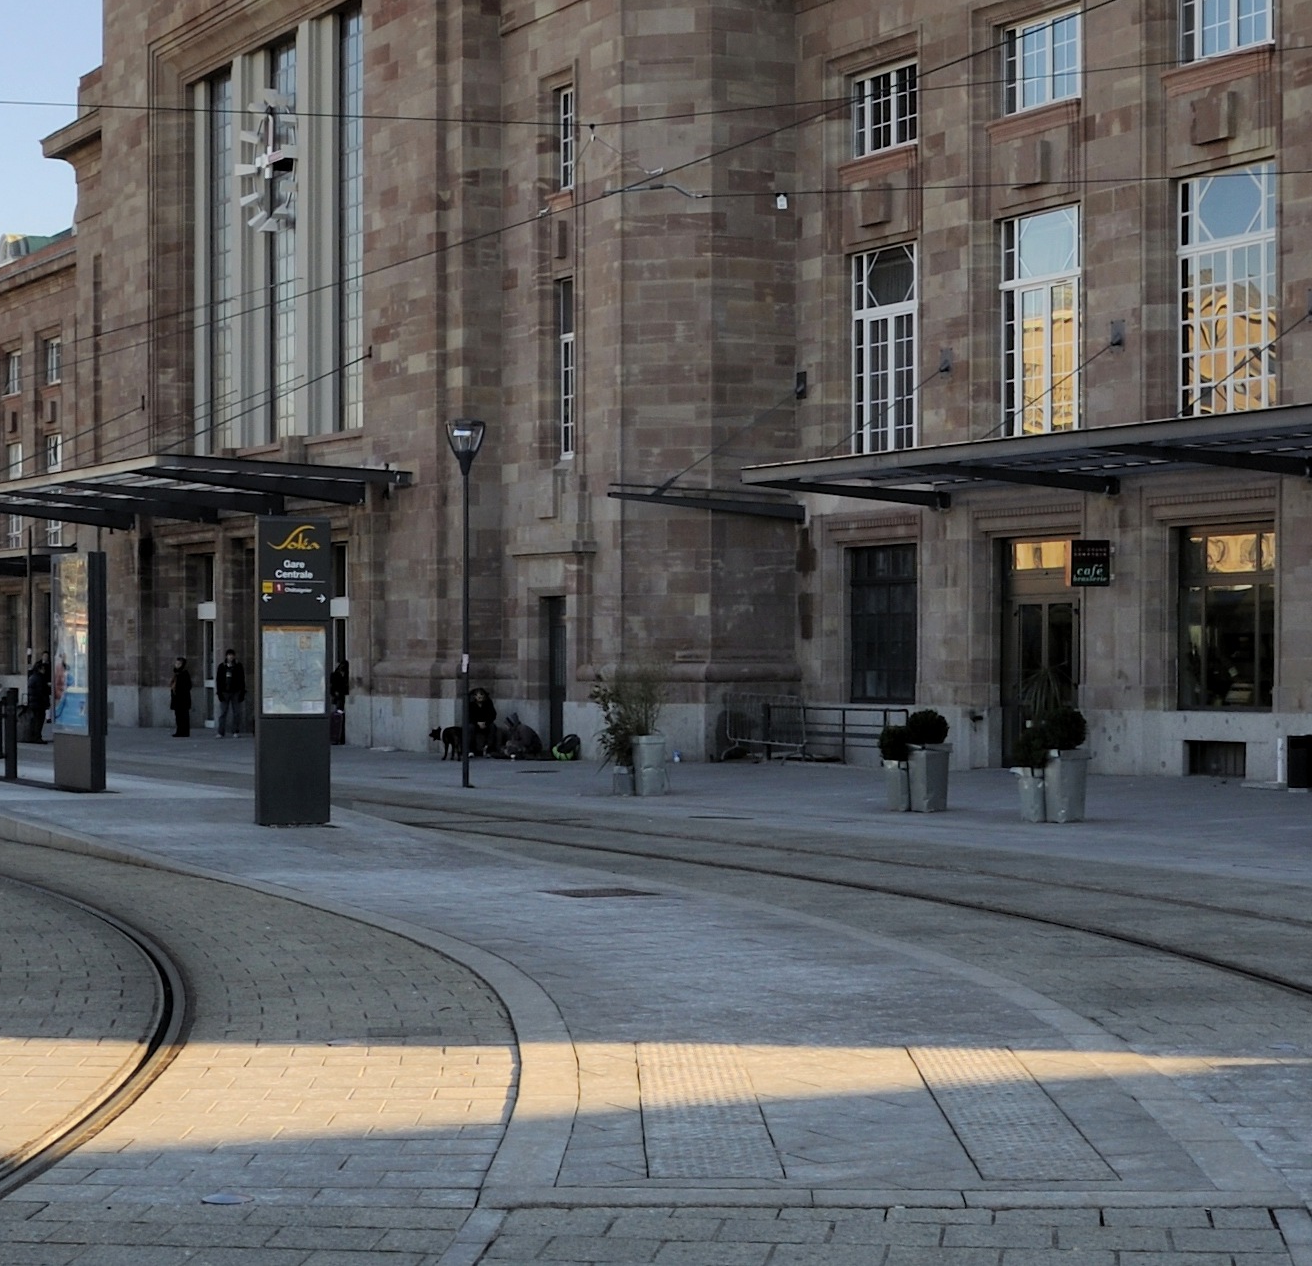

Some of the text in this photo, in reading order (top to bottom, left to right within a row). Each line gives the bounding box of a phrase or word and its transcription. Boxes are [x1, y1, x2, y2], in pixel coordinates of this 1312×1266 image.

[283, 559, 306, 569] Gare
[275, 569, 314, 580] Centrale
[1076, 563, 1104, 579] café
[1073, 573, 1108, 583] brasserie
[276, 583, 281, 592] 1
